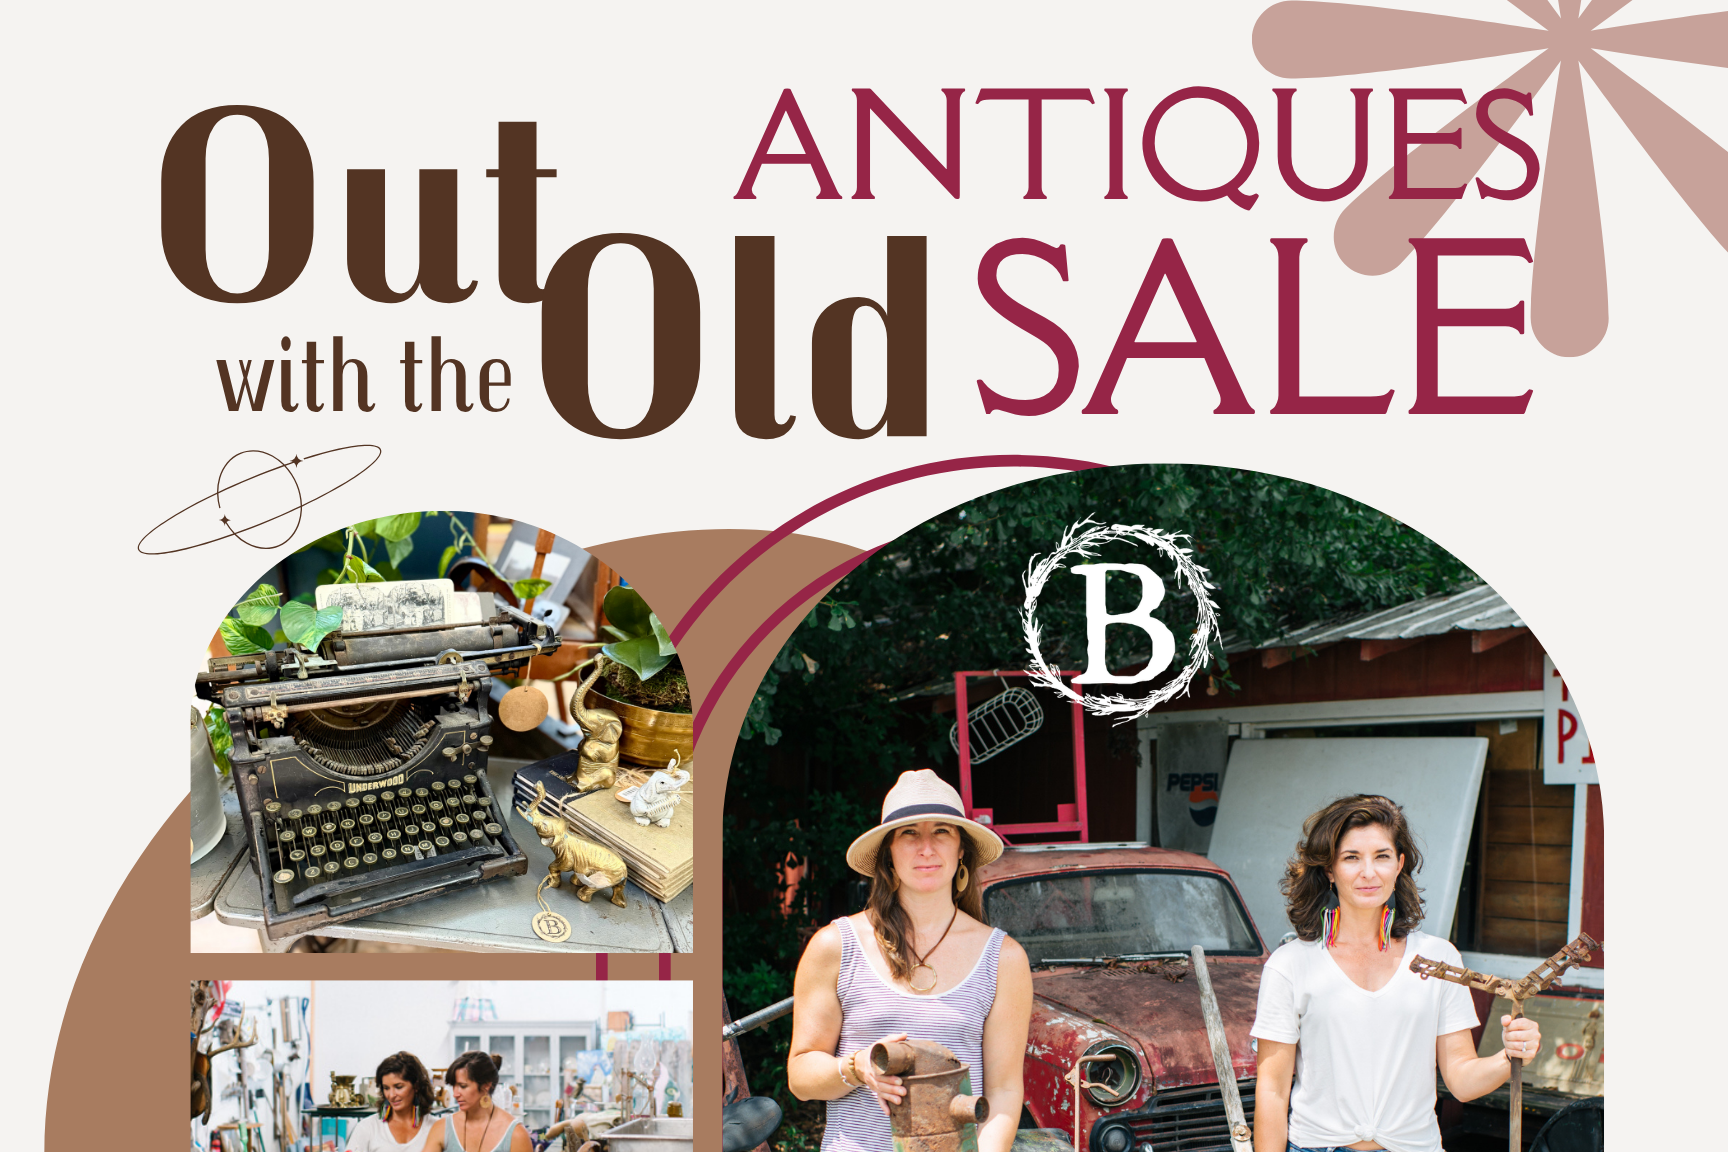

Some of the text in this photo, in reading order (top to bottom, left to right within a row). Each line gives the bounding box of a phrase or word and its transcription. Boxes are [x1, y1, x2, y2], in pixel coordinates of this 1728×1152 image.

[160, 104, 558, 304] Out
[734, 86, 1540, 211] ANTIQUES
[216, 336, 511, 412] with the
[541, 232, 927, 440] Old
[976, 237, 1534, 417] SALE
[1070, 562, 1176, 686] B
[347, 773, 405, 794] UNDERWOOD
[1166, 772, 1219, 792] PEPSI
